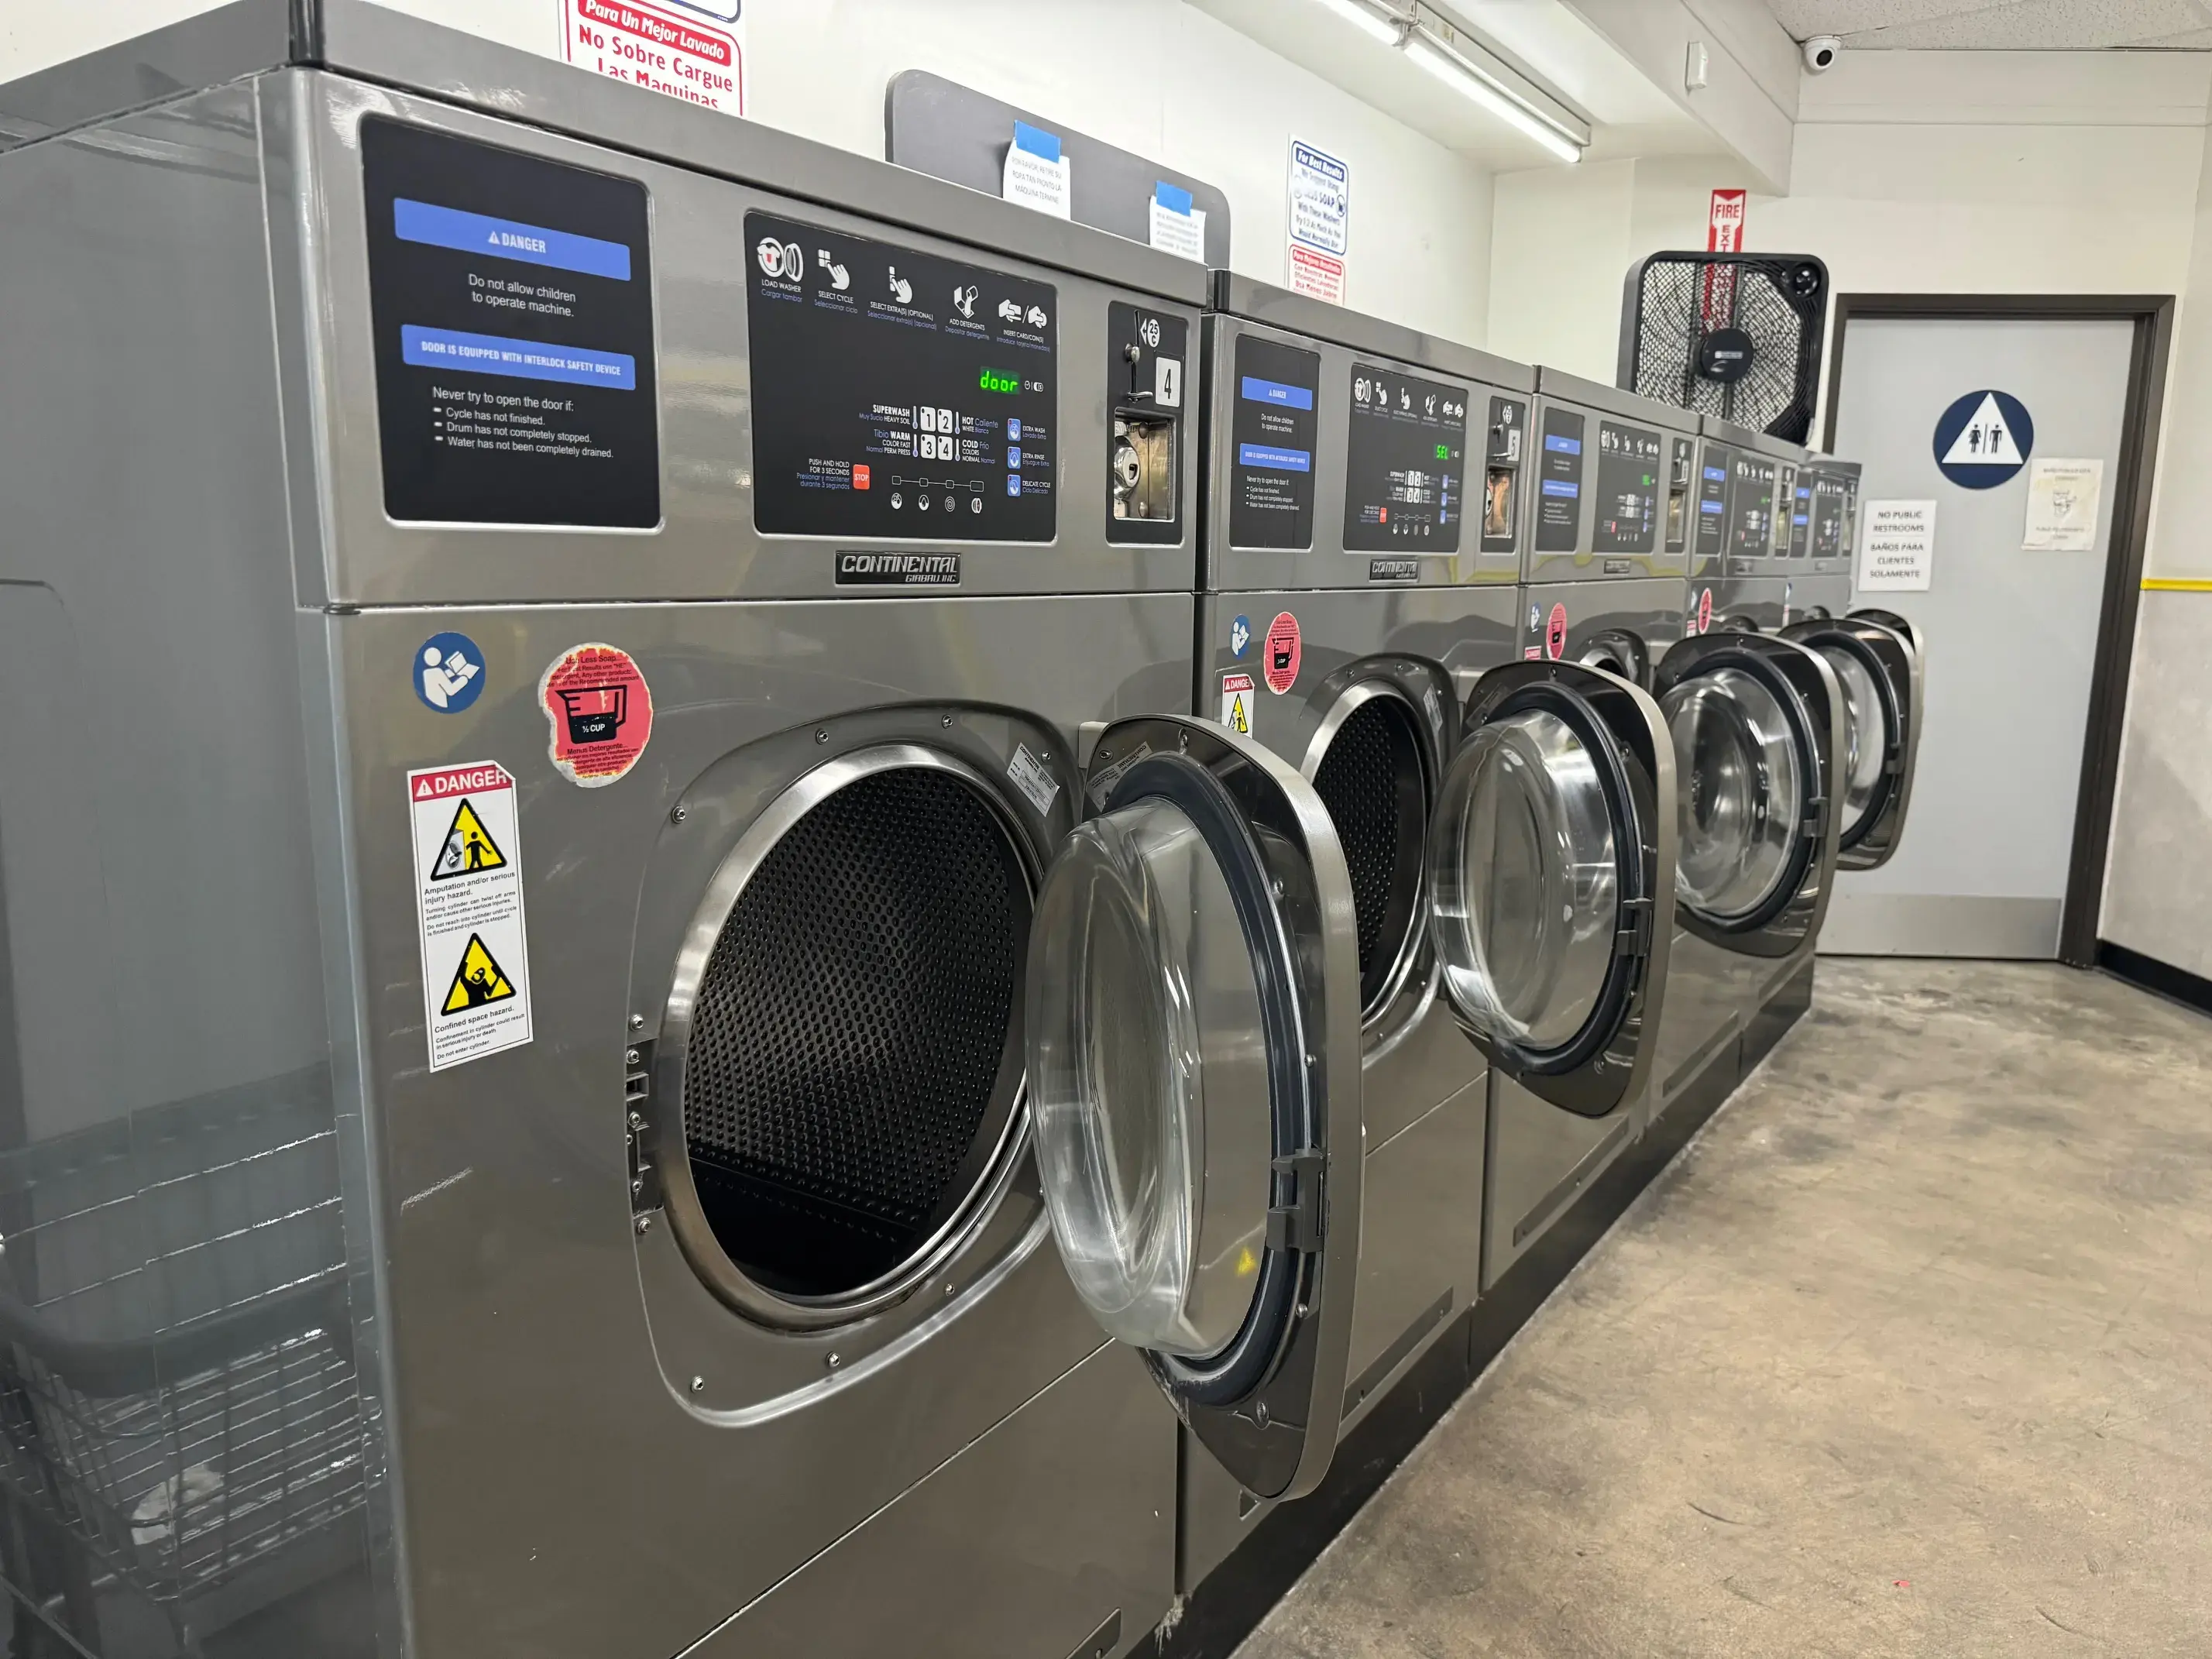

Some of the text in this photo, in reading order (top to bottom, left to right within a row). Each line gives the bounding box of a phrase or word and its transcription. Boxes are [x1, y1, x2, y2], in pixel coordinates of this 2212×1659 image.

[586, 0, 724, 60] Para Un Mejor Lavado
[579, 24, 733, 92] No Sobre Cargue
[1715, 204, 1740, 218] FIRE
[502, 232, 546, 253] DANGER
[469, 273, 576, 303] Do not allow children
[761, 279, 802, 293] LOAD WASHER
[472, 291, 575, 318] to operate machine.
[819, 290, 854, 304] SELECT CYCLE
[1149, 323, 1158, 335] 25
[421, 341, 621, 376] DOOR IS EQUIPPED WITH INTERLOCK SAFETY DEVICE
[980, 370, 1018, 391] door
[1164, 369, 1171, 399] 4
[433, 386, 575, 412] Never try to open the door if:
[446, 407, 546, 426] Cycle has not finished.
[873, 404, 910, 417] SUPERWASH
[884, 415, 899, 424] HEAVY
[900, 417, 910, 425] SOIL
[926, 413, 931, 428] 1
[943, 415, 949, 429] 2
[962, 416, 998, 428] HOT Caliente
[447, 421, 592, 445] Drum has not completely stopped.
[874, 428, 911, 441] Tibio WARM
[448, 436, 614, 459] Water has not been completely drained.
[882, 439, 899, 448] COLOR
[884, 446, 897, 455] PERM
[926, 441, 933, 455] 3
[943, 442, 949, 456] 4
[962, 439, 977, 449] COLD
[854, 473, 868, 482] STOP
[1873, 524, 1925, 533] RESTROOMS
[842, 555, 957, 573] CONTINENTAL
[1877, 557, 1915, 565] CLIENTES
[1870, 570, 1920, 579] SOLAMENTE
[581, 655, 598, 664] Less
[590, 724, 605, 733] CUP
[434, 769, 507, 795] DANGER
[424, 871, 515, 897] Amputation and/or serious
[425, 888, 473, 905] injury hazard.
[426, 905, 446, 915] Turning
[448, 900, 469, 911] cylinder
[426, 913, 443, 922] and/or
[459, 905, 473, 914] other
[473, 902, 492, 911] serious
[434, 1005, 514, 1033] Confined space hazard.
[455, 1046, 469, 1054] enter
[469, 1039, 491, 1051] cylinder.
